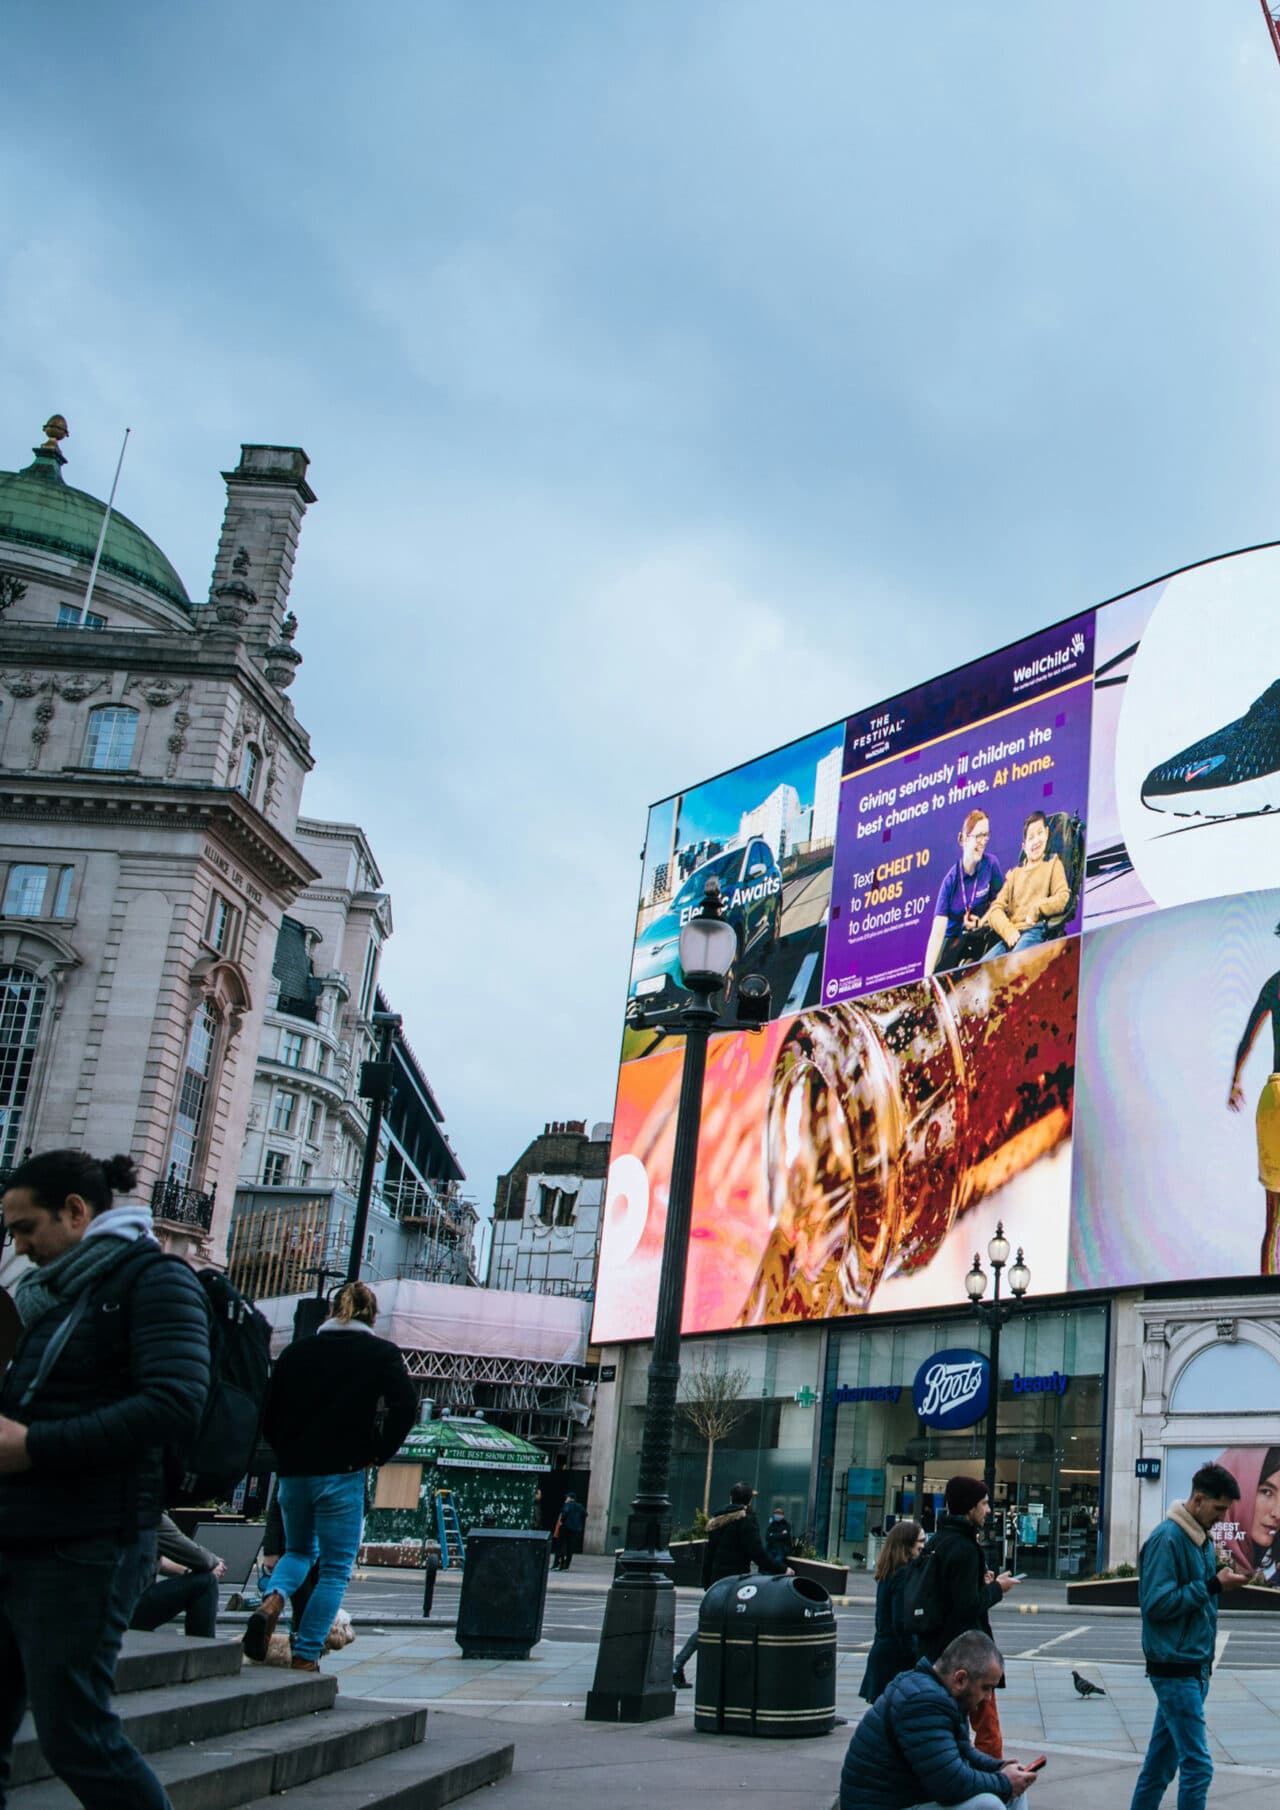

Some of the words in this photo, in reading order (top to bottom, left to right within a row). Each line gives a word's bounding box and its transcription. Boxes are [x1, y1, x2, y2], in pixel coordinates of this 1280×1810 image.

[1013, 646, 1070, 684] WellChild
[870, 713, 890, 731] THE
[859, 790, 897, 813] Giving
[899, 762, 954, 798] seriously
[957, 755, 969, 776] ill
[971, 740, 1025, 770] children
[1028, 727, 1052, 748] the
[856, 816, 884, 839] best
[885, 801, 929, 828] chance
[932, 794, 945, 811] to
[948, 779, 990, 805] thrive.
[992, 768, 1009, 789] At
[1011, 754, 1055, 781] home.
[853, 868, 875, 890] Text
[876, 854, 914, 882] CHELT
[916, 848, 930, 869] 10
[730, 876, 780, 909] Awaits
[850, 897, 862, 913] to
[864, 880, 903, 909] 70085
[848, 920, 860, 936] to
[862, 906, 902, 931] donate
[833, 1384, 903, 1407] pharmacy
[918, 1361, 983, 1416] Boots
[1013, 1370, 1069, 1396] beauty
[485, 1451, 506, 1460] SHOW
[1224, 1531, 1233, 1540] IS
[1235, 1531, 1246, 1541] AT
